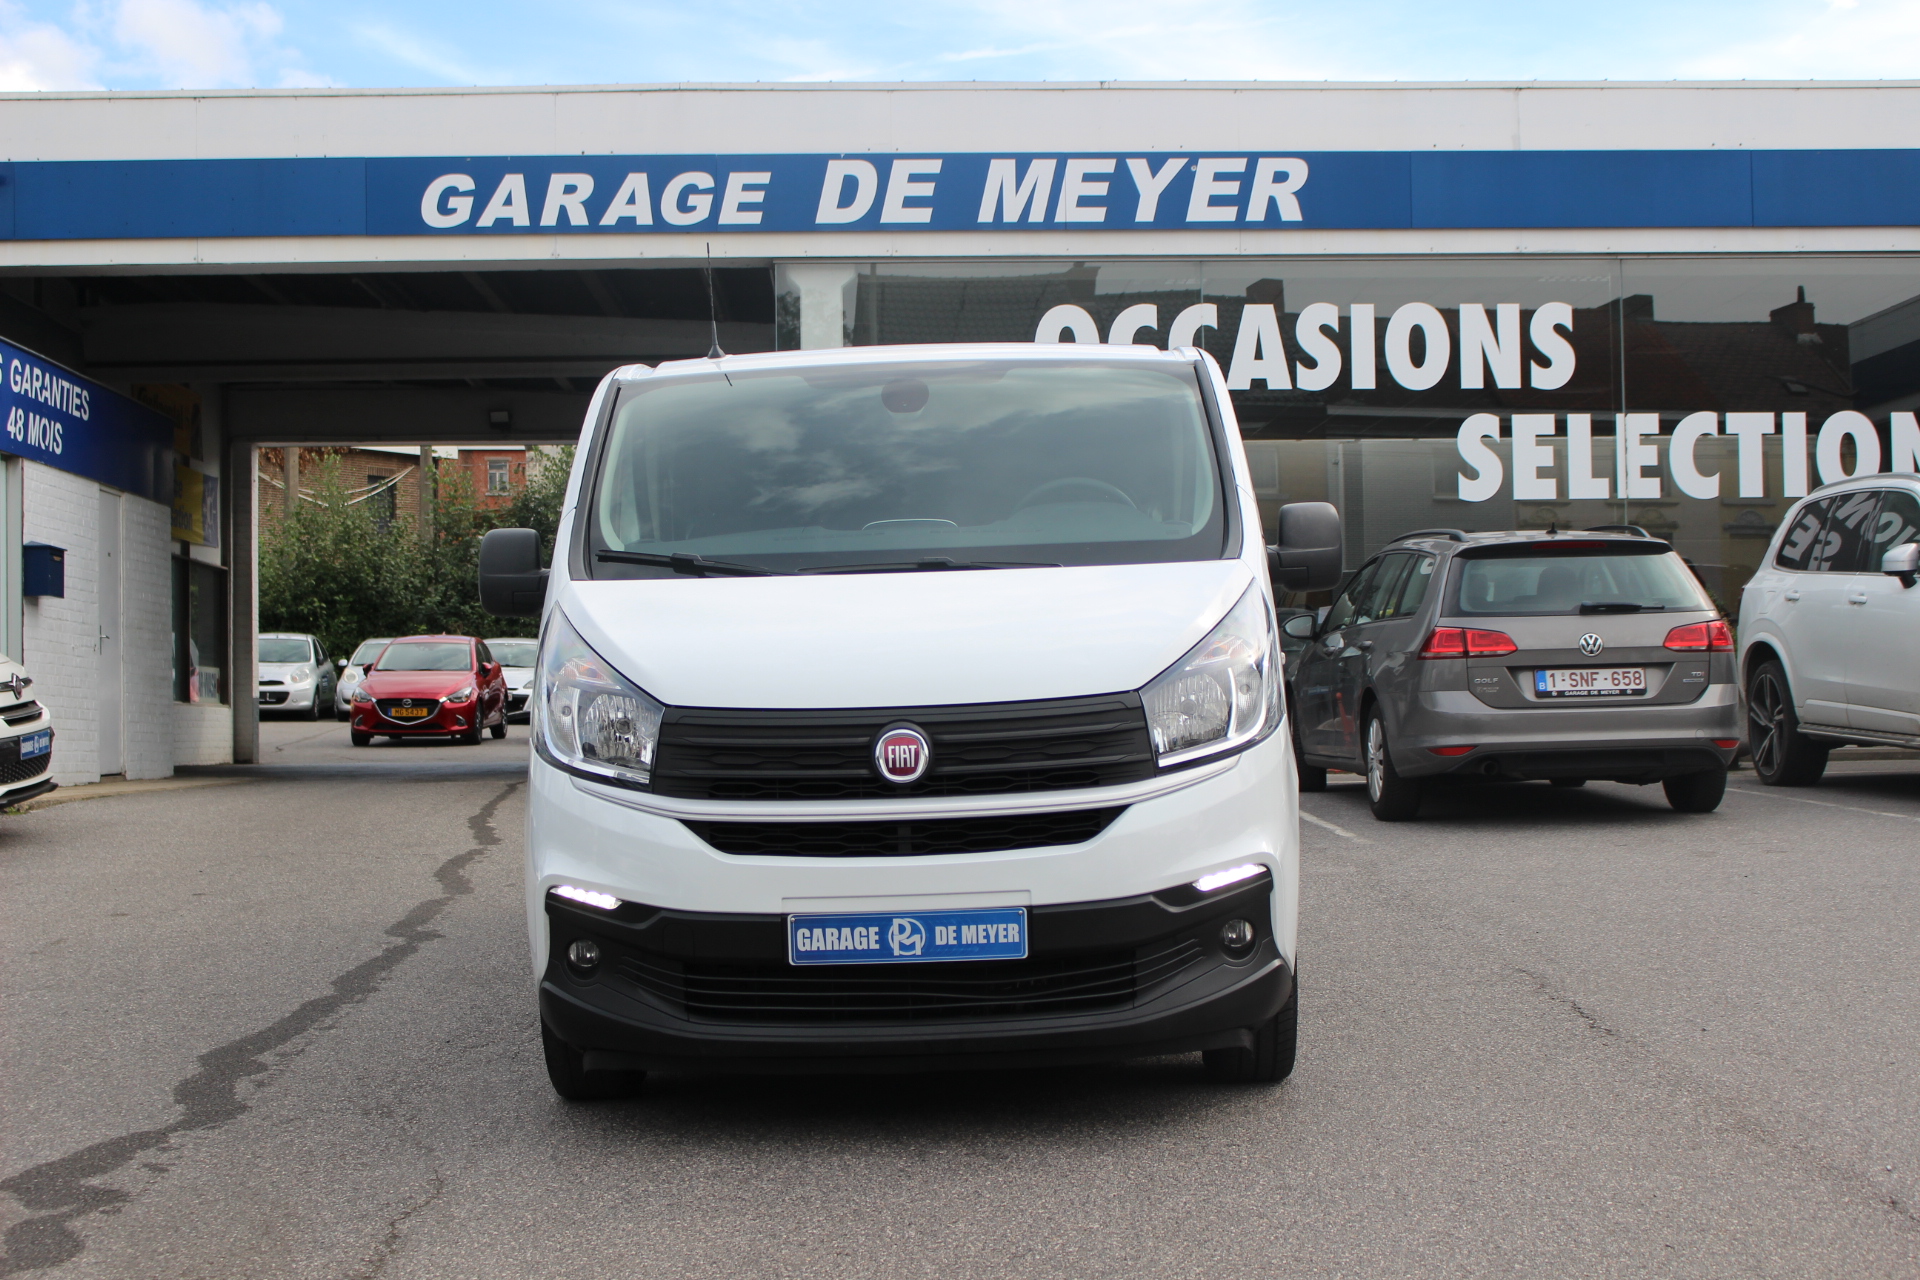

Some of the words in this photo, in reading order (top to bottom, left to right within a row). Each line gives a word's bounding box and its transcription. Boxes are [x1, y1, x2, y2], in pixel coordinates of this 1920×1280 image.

[420, 171, 772, 229] GARAGE
[814, 158, 942, 225] DE
[977, 157, 1309, 224] MEYER
[10, 358, 90, 421] GARANTIES
[7, 405, 25, 442] 48
[27, 411, 63, 455] MOIS
[1474, 676, 1499, 684] GOLF
[1539, 682, 1546, 690] B
[887, 745, 918, 768] FIAT
[796, 927, 880, 951] GARAGE
[935, 925, 957, 945] DE
[961, 923, 1020, 944] MEYER
